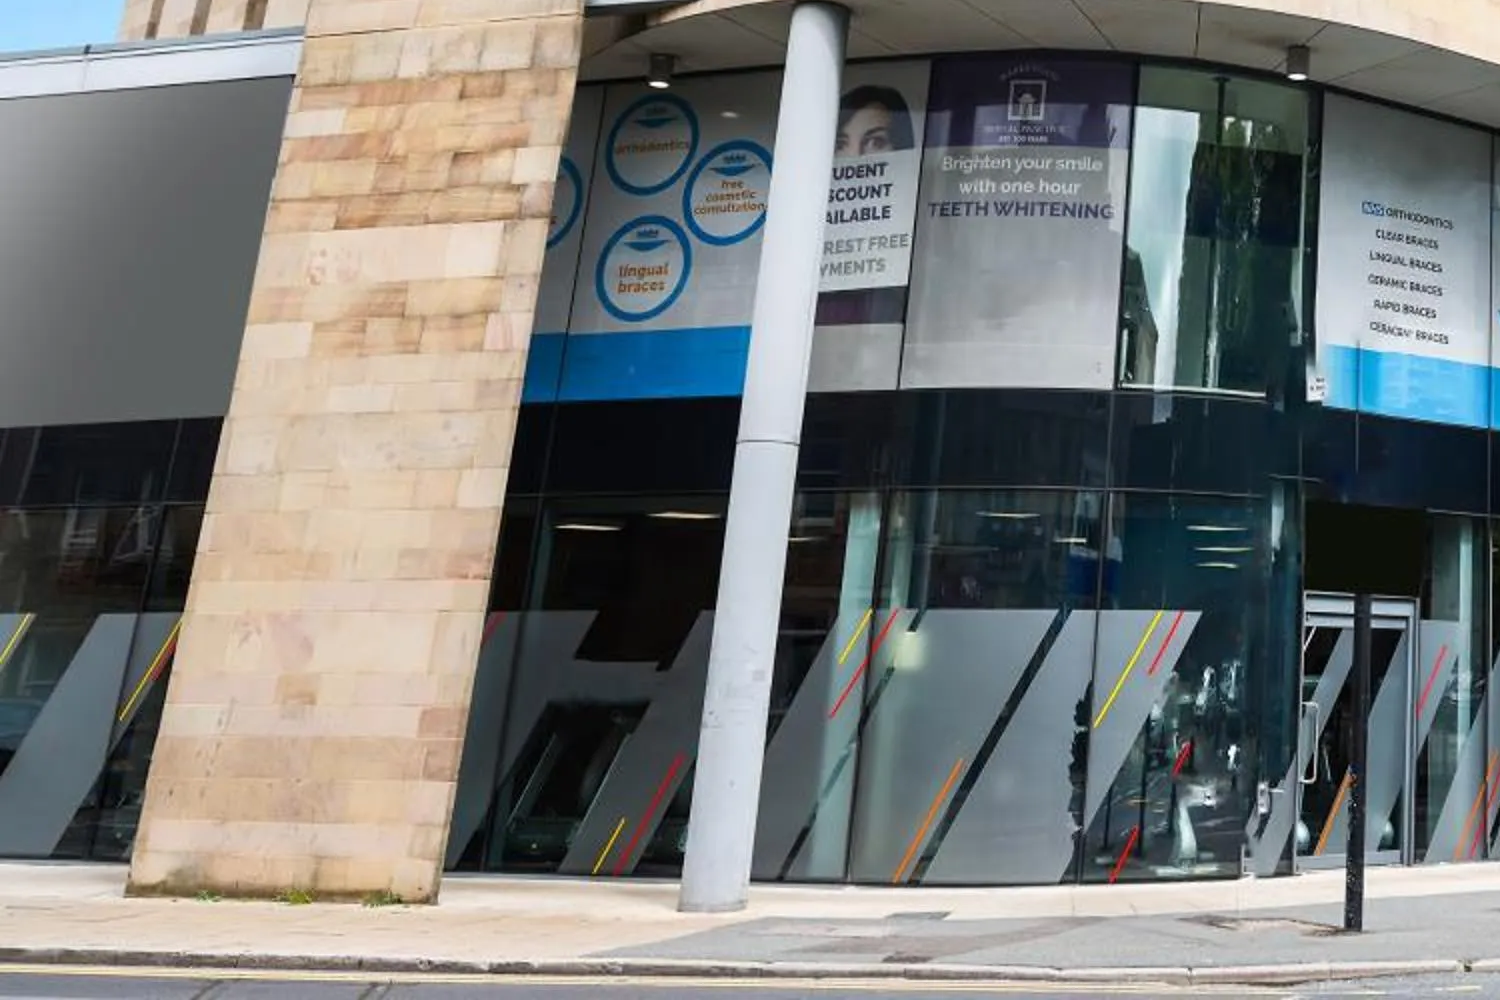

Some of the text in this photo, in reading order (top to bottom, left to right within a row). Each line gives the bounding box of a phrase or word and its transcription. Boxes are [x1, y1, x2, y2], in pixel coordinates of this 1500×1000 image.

[832, 162, 889, 181] UDENT
[942, 156, 1103, 174] Brighten your smile
[828, 183, 894, 203] SCOUNT
[959, 180, 1081, 195] with one hour
[826, 205, 892, 225] AILABLE
[928, 201, 1116, 220] TEETH WHITENING
[1386, 207, 1455, 231] ORTHODONTICS
[823, 233, 910, 255] REST FREE
[1376, 229, 1439, 250] CLEAR BRACES
[820, 258, 886, 277] YMENTS
[1369, 250, 1443, 273] LINGUAL BRACES
[618, 262, 670, 281] lingual
[617, 278, 666, 294] braces
[1368, 273, 1443, 297] CERAMIC BRACES
[1374, 299, 1437, 319] RAPID BRACES
[1415, 329, 1449, 345] BRACES
